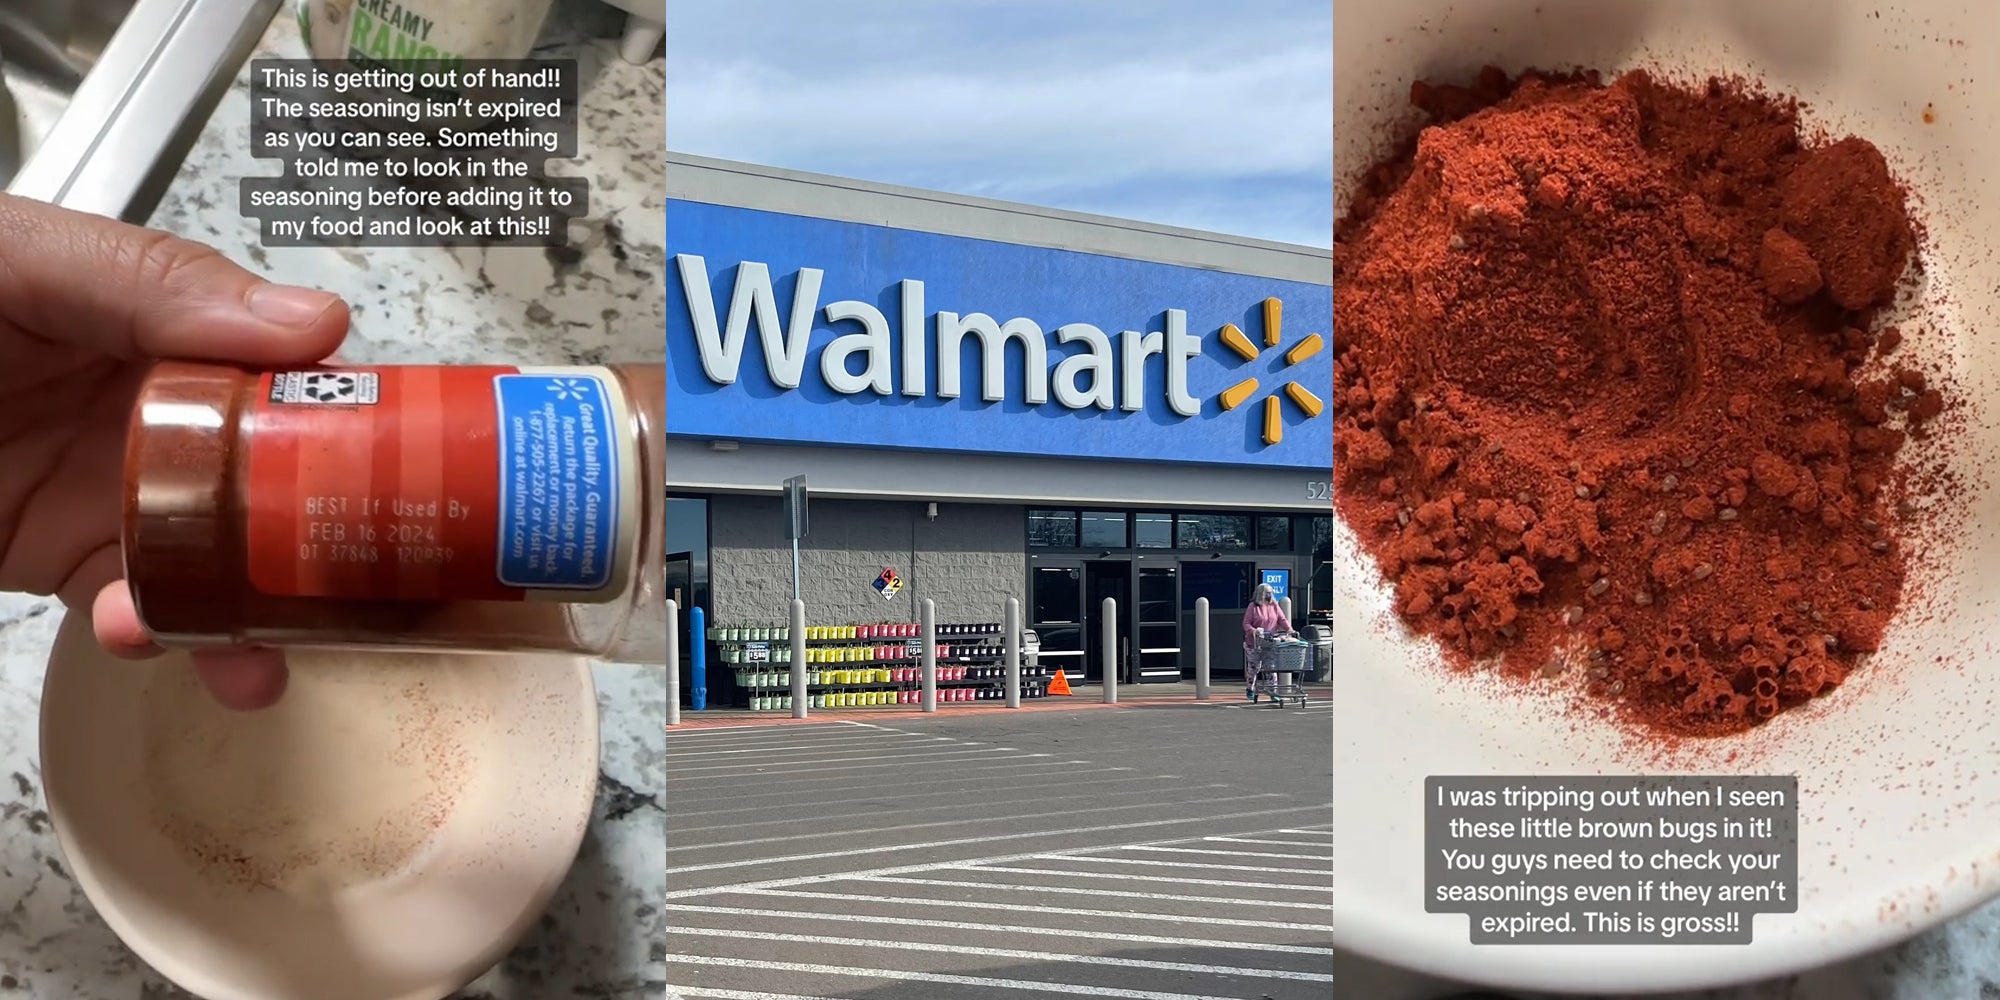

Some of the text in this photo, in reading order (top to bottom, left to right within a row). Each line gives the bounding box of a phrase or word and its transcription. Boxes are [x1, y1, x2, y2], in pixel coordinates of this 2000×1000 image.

[677, 254, 1201, 416] Walmart
[579, 403, 596, 434] Great
[543, 402, 561, 474] replacement
[512, 416, 529, 559] online at walmart.com
[528, 410, 546, 570] 1-877-505-2267 or visit us
[549, 477, 560, 492] or
[562, 416, 580, 560] Return the package for
[306, 497, 471, 521] BEST If Used By
[543, 494, 560, 542] money
[309, 522, 436, 543] FEB 16 2024
[581, 491, 601, 577] Guaranteed.
[883, 570, 892, 580] 4
[892, 578, 901, 588] 2
[1266, 575, 1283, 583] EXIT
[1271, 586, 1285, 594] NLY
